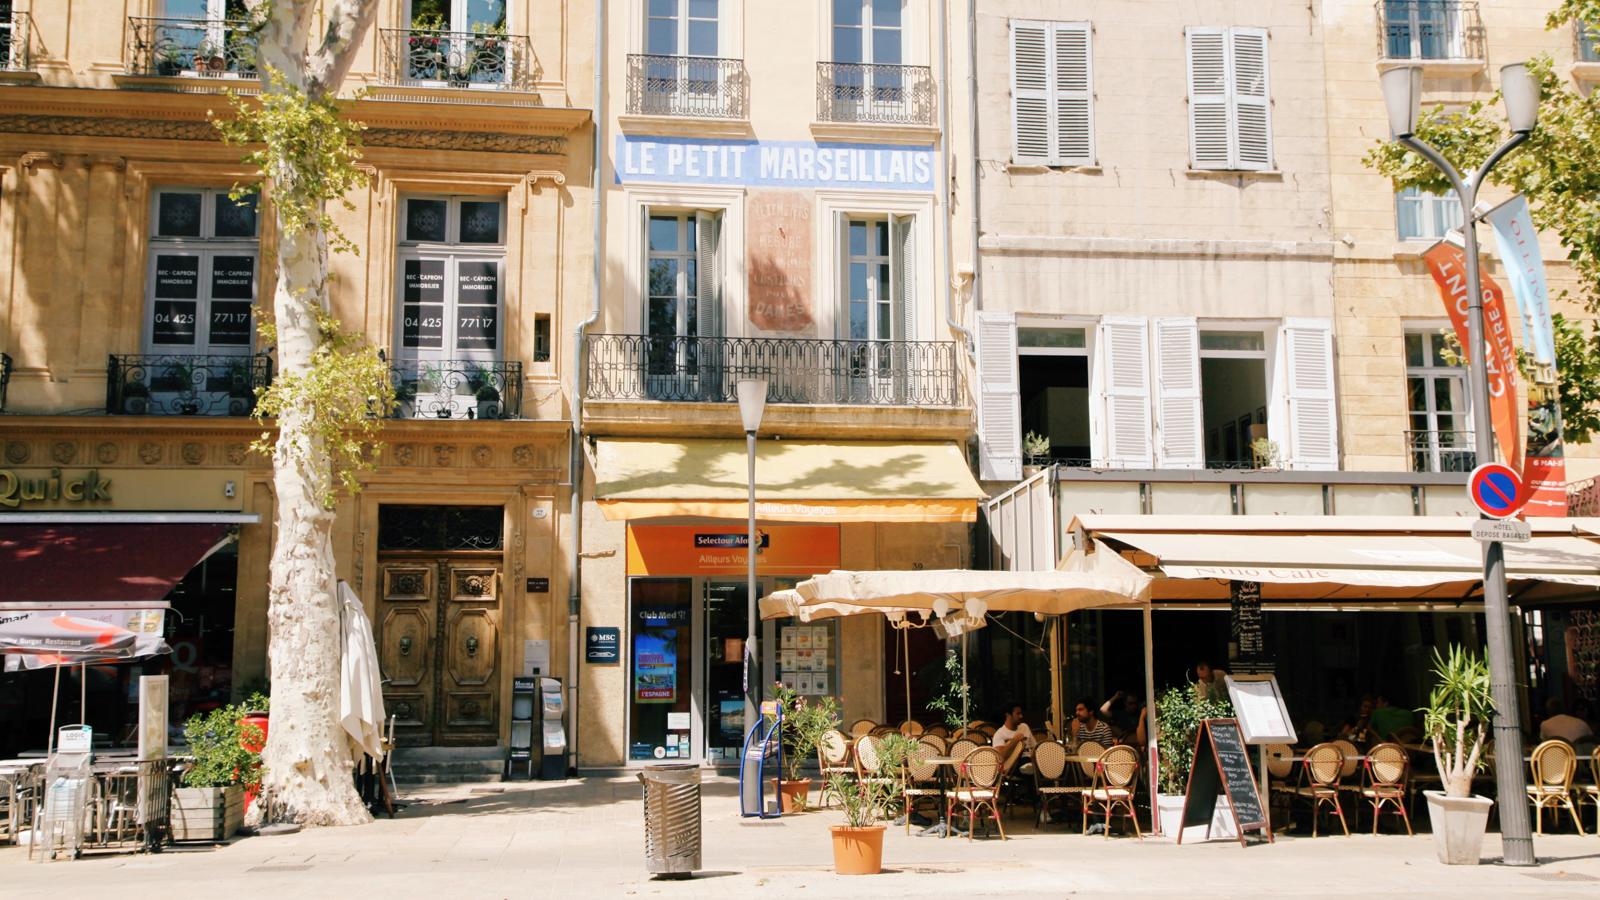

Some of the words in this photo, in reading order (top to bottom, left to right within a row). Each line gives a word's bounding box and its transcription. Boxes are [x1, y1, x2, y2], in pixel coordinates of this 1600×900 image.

[625, 142, 656, 175] LE
[668, 144, 746, 178] PETIT
[760, 147, 931, 184] MARSEILLAIS
[759, 235, 802, 249] MESURE
[755, 301, 805, 318] DAMES
[155, 314, 169, 323] 04
[173, 314, 194, 324] 425
[214, 313, 233, 323] 771
[237, 314, 247, 323] 17
[405, 317, 418, 327] 04
[422, 317, 441, 328] 425
[461, 318, 479, 328] 771
[483, 318, 493, 328] 17
[1490, 306, 1518, 387] CENTRE
[0, 467, 112, 507] Quick
[755, 504, 792, 513] Ailleurs
[793, 504, 837, 516] Voyages
[698, 536, 733, 544] Selectour
[699, 555, 730, 563] Ailleurs
[20, 637, 42, 646] Burger
[170, 642, 199, 674] Q
